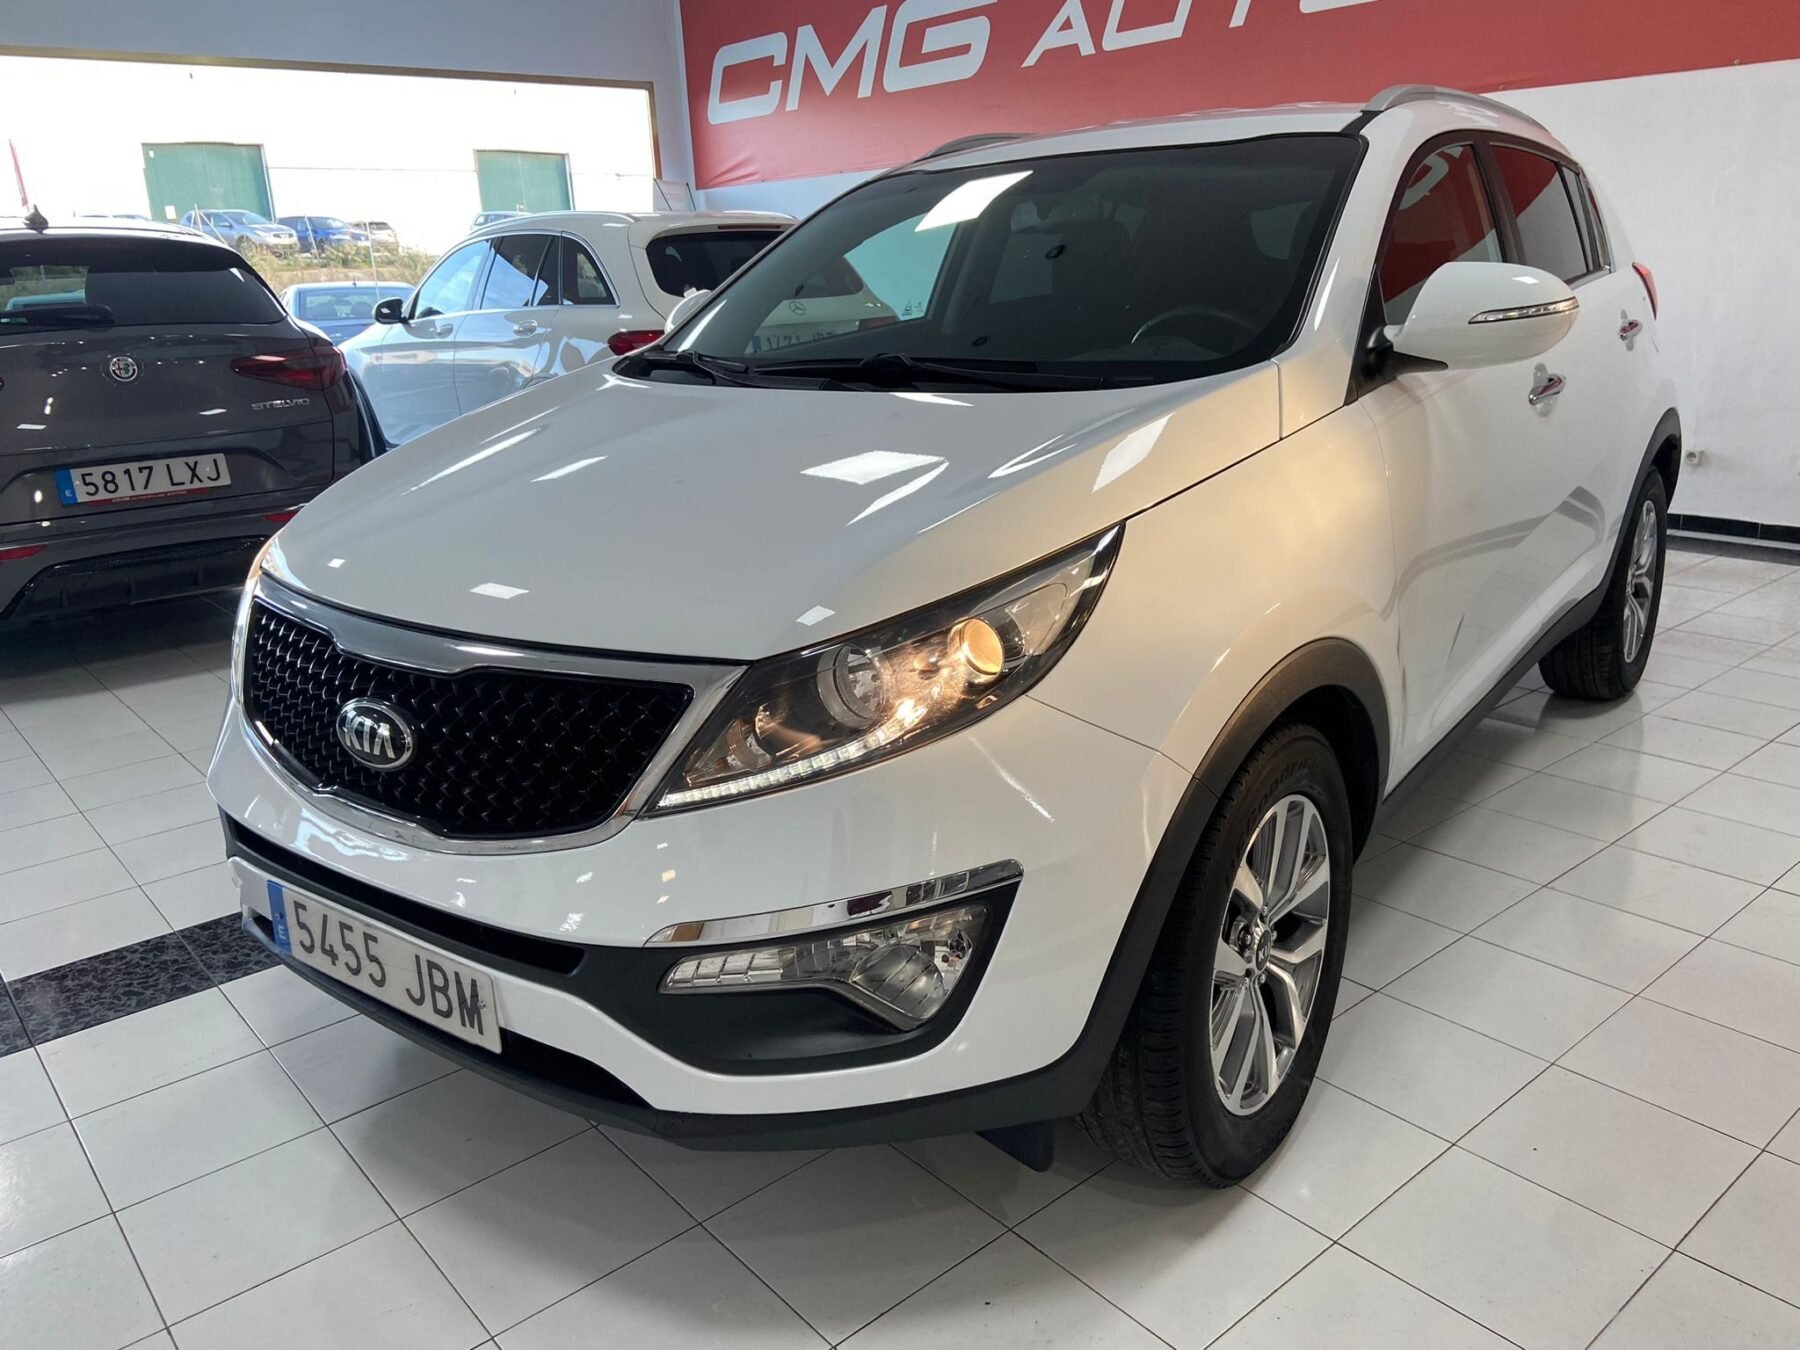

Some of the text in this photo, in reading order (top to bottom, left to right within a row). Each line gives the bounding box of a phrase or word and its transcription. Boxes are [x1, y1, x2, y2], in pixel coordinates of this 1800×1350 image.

[707, 0, 1382, 124] CMG AU
[250, 398, 310, 410] STELVIO
[81, 465, 154, 497] 5817
[166, 458, 222, 487] LXJ
[344, 709, 396, 759] KIA
[277, 924, 287, 940] E
[293, 900, 484, 1036] 5455 JBM
